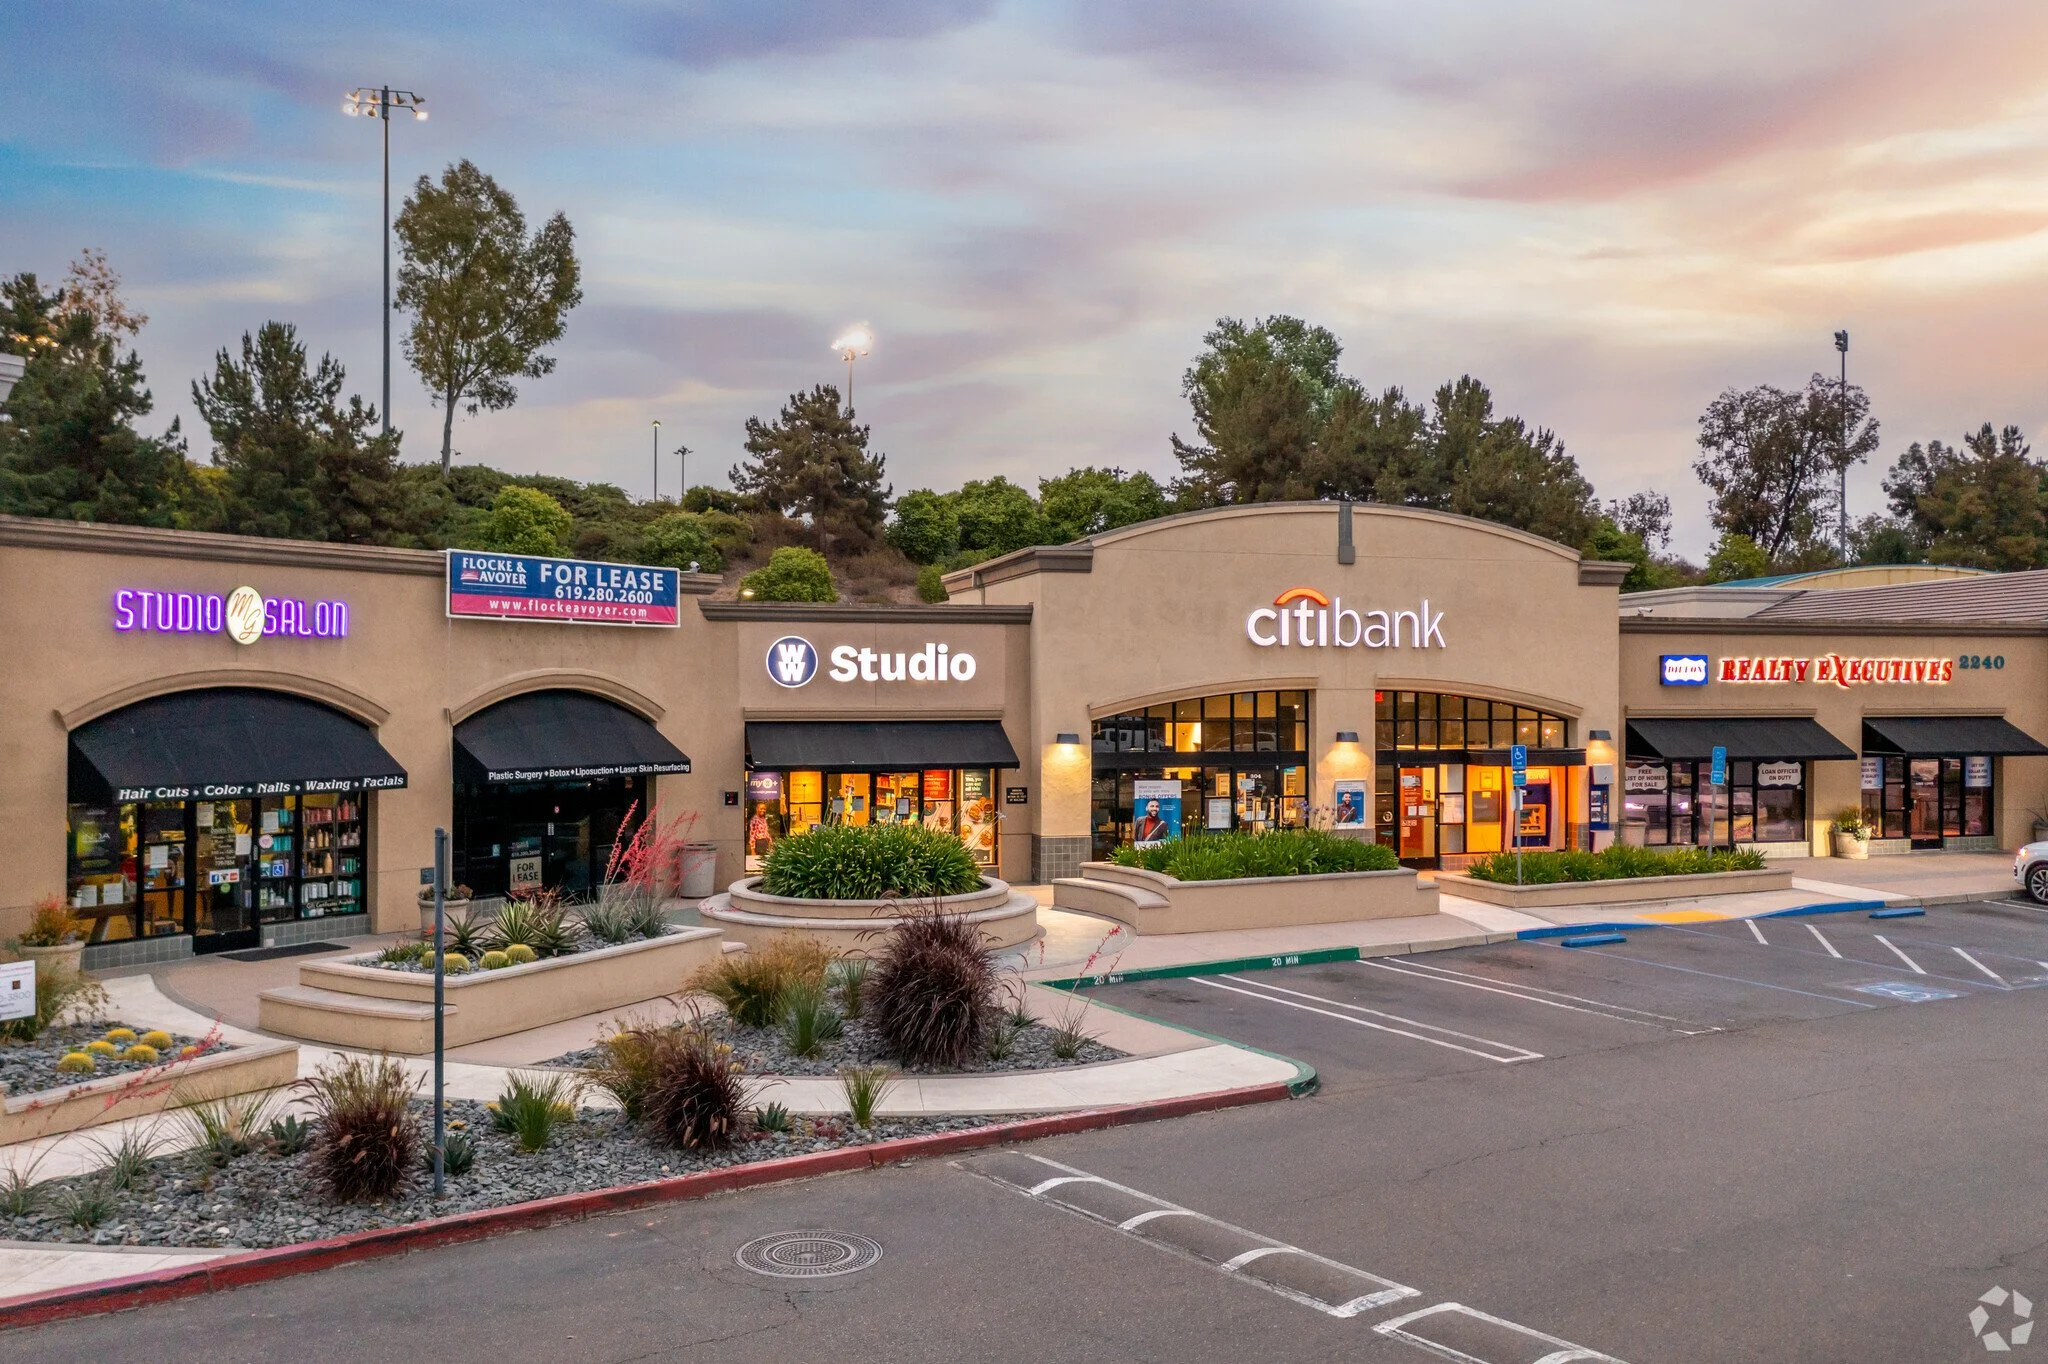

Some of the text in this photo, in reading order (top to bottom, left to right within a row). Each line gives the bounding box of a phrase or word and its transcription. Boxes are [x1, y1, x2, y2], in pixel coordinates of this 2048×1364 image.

[463, 557, 527, 572] FLOCKE &
[479, 571, 527, 585] AVOYER
[540, 563, 664, 591] FOR LEASE
[555, 586, 653, 604] 619.280.2600
[116, 590, 222, 632] STUDIO
[263, 599, 347, 637] SALON
[489, 600, 647, 617] www.flockeavoyer.com
[1246, 596, 1446, 649] citibank
[829, 642, 977, 682] Studio
[1959, 655, 2005, 669] 2240
[1720, 655, 1954, 688] REALTY EXECUTIVES
[488, 763, 690, 780] Plastic Surgery Botox Liposuction Laser Skin Resurfacing
[119, 775, 404, 800] Hair Cuts Color Nails Waxing Facials
[516, 862, 535, 873] FOR
[1272, 955, 1299, 967] 20 MIN
[1094, 972, 1124, 985] 20 MIN
